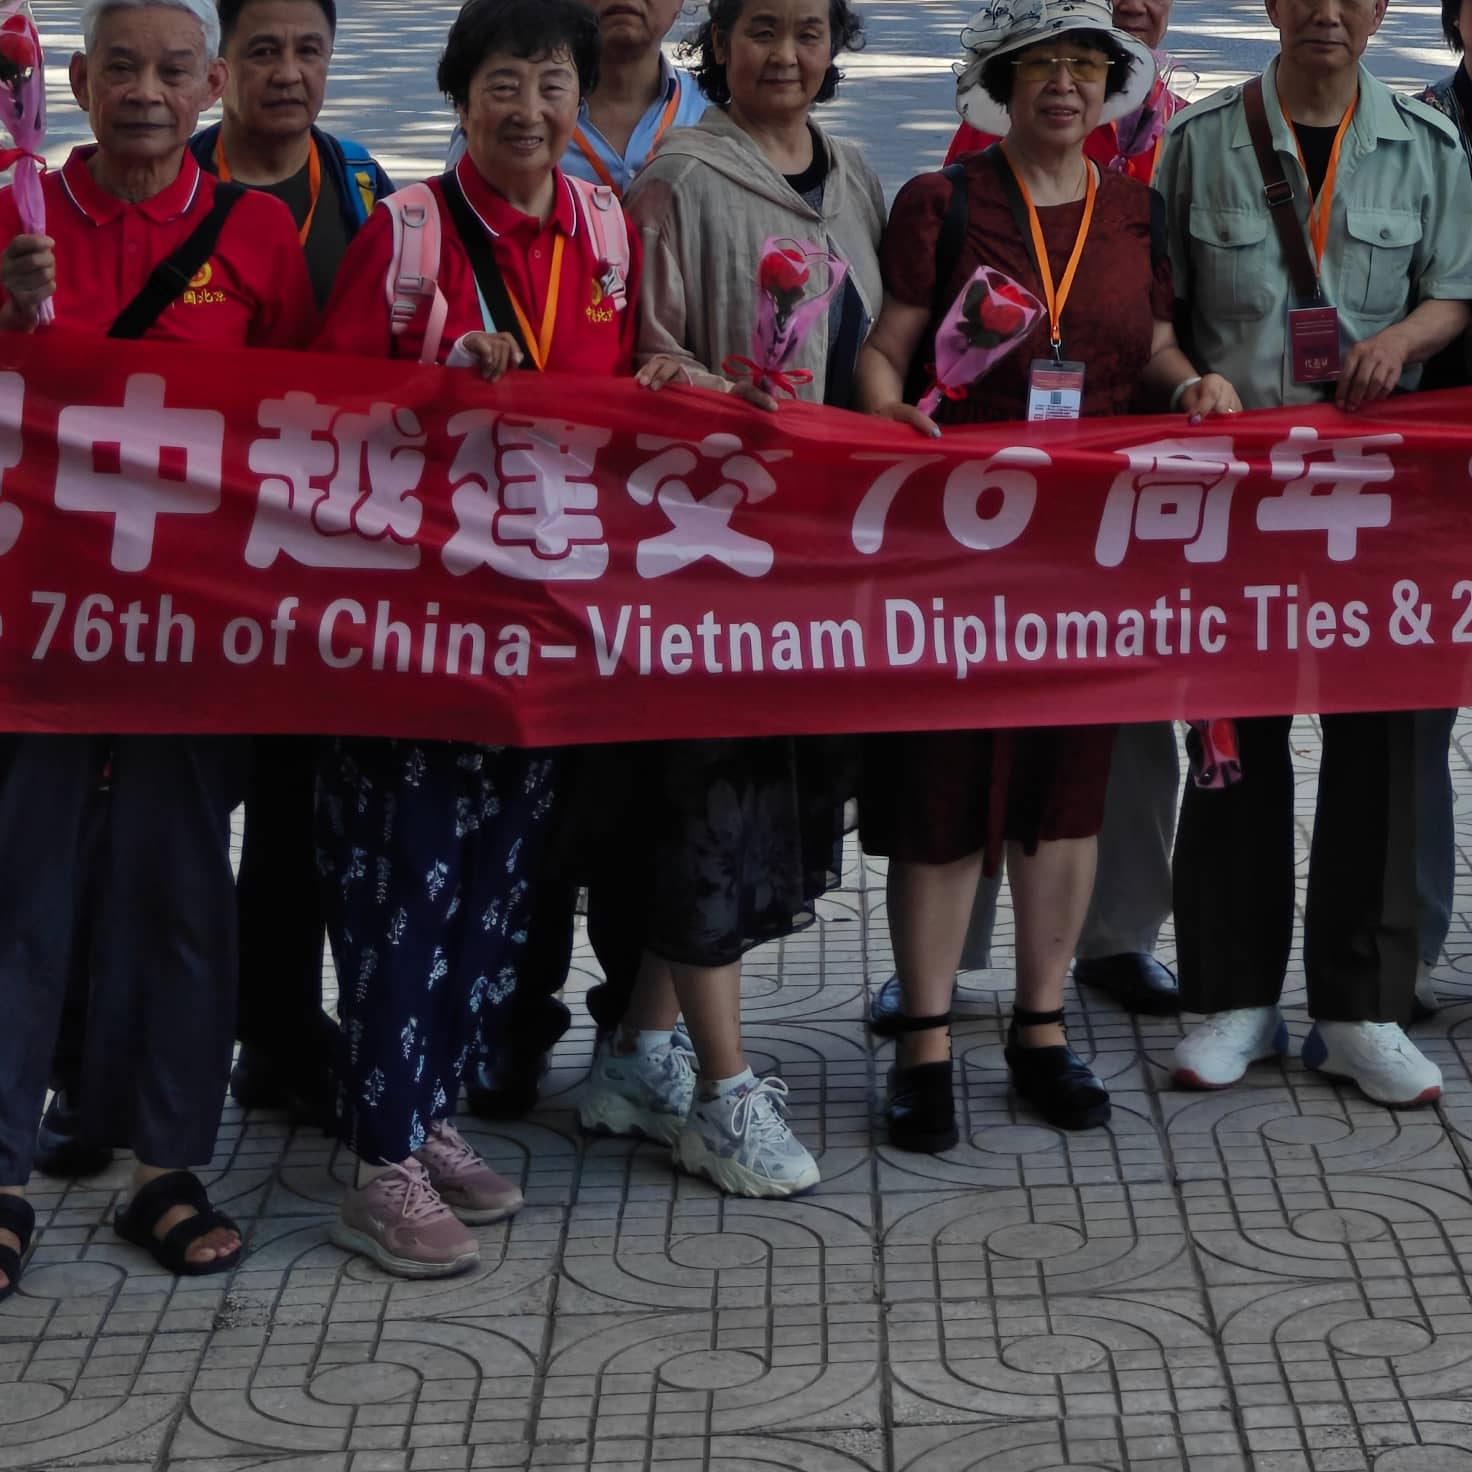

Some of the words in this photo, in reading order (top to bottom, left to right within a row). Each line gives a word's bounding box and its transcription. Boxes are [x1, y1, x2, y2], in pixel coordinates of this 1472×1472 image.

[170, 289, 226, 310] 国北京
[31, 591, 196, 663] 76th
[223, 596, 298, 665] of
[885, 588, 1227, 679] Diplomatic
[1244, 584, 1371, 651] Ties
[1388, 579, 1435, 646] &
